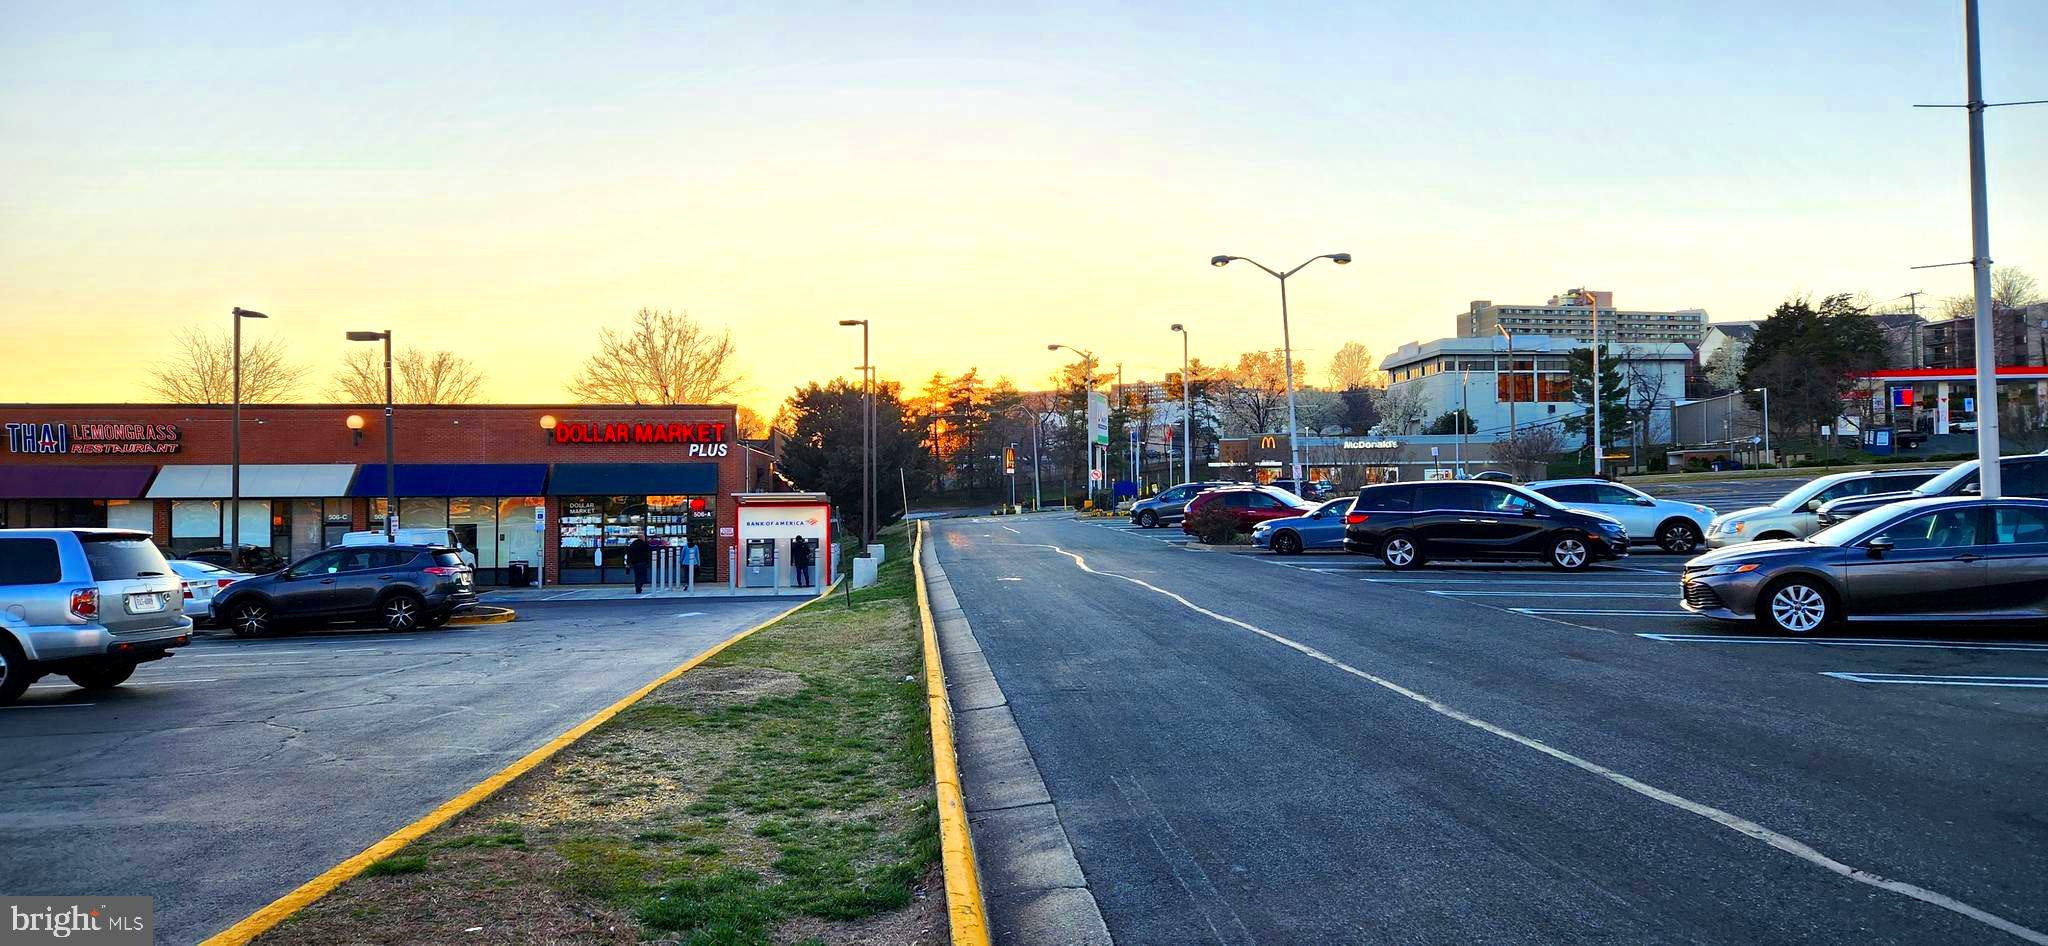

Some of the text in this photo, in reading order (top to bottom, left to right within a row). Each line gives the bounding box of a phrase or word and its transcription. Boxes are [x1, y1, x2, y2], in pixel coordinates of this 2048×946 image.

[5, 423, 178, 453] THAI LEMONGRASS
[556, 422, 726, 443] DOLLAR MARKET
[70, 443, 179, 454] RESTAURANT
[688, 443, 728, 457] PLUS
[1343, 441, 1399, 449] McDonald's
